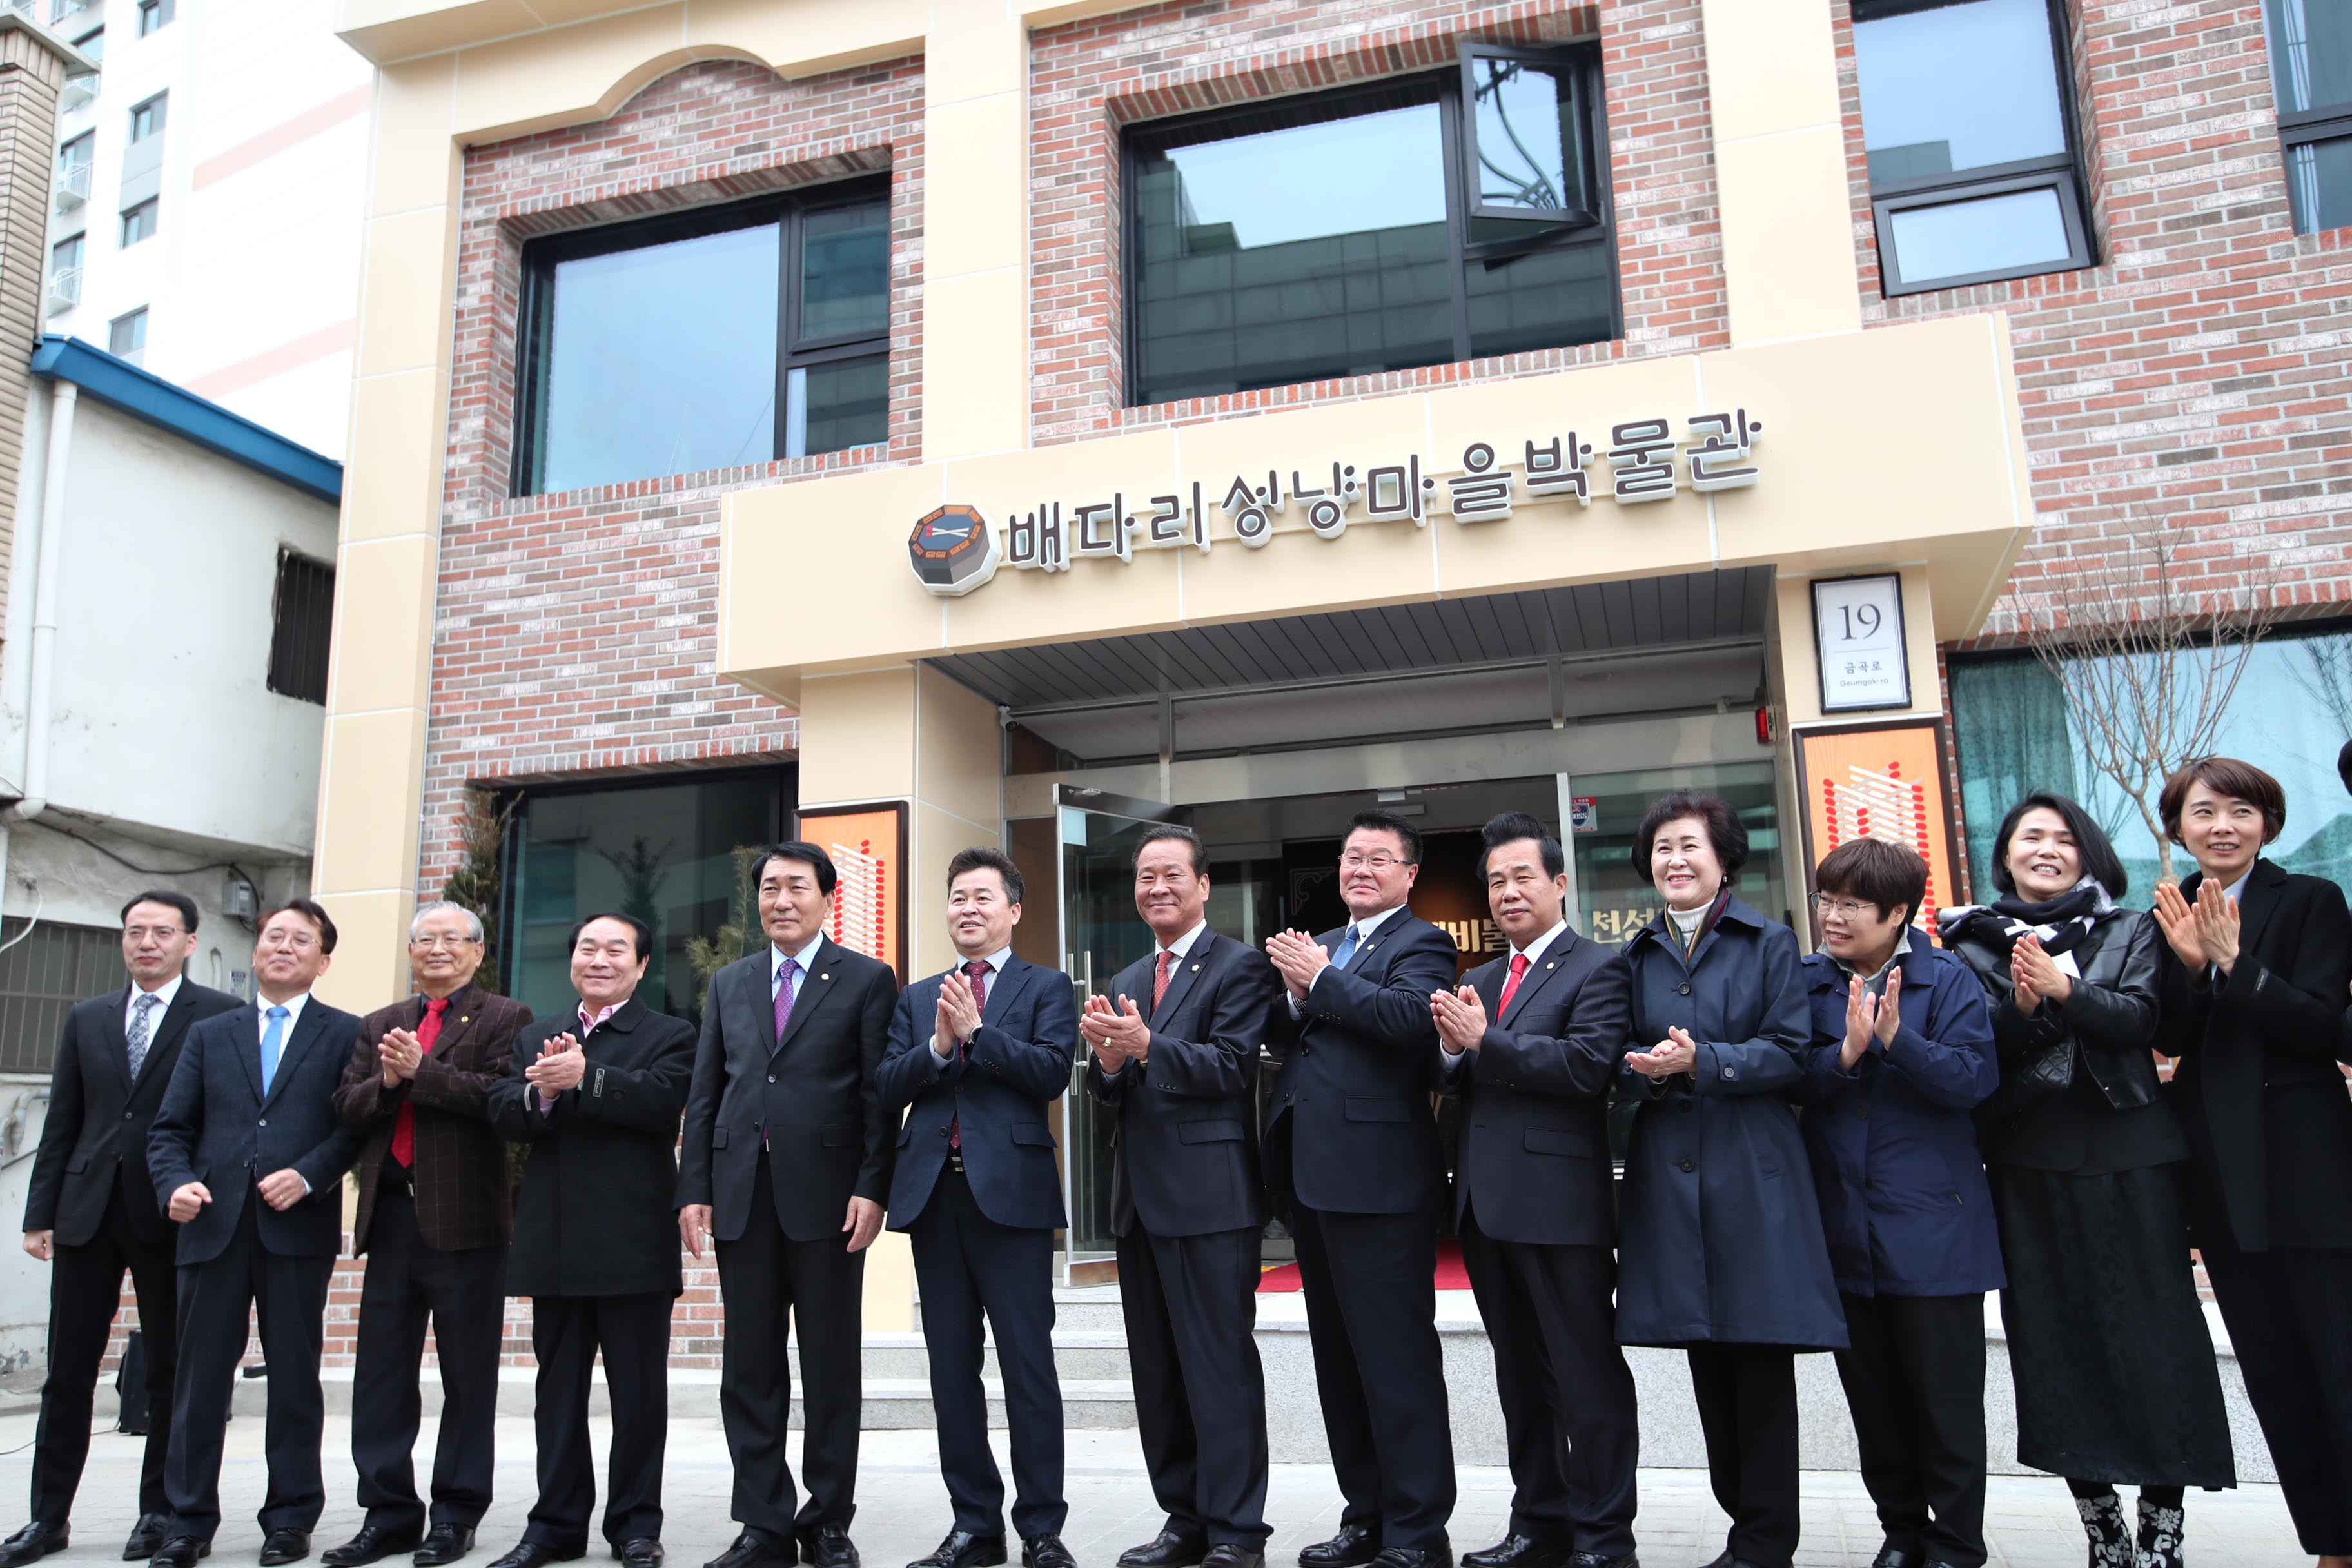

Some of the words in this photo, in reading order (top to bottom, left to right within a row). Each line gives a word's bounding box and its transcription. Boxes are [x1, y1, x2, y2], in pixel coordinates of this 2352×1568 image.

[1009, 407, 1763, 565] 배다리성냥마을박물관
[1838, 603, 1881, 641] 19
[1845, 660, 1883, 675] 금곡로
[1839, 678, 1889, 687] Geumgok-ro
